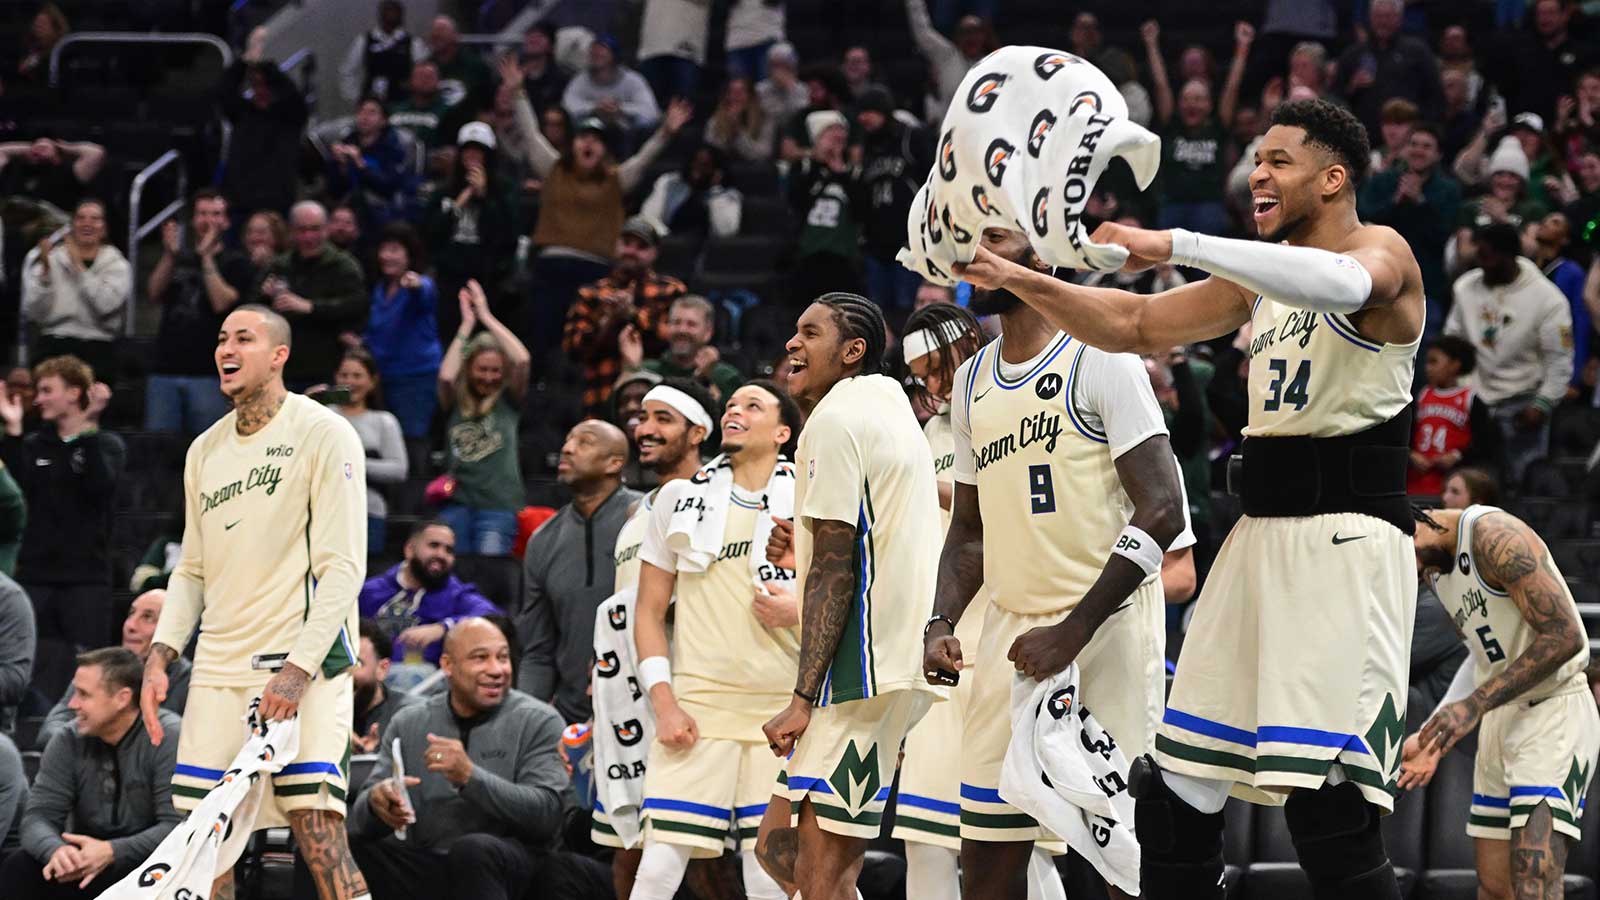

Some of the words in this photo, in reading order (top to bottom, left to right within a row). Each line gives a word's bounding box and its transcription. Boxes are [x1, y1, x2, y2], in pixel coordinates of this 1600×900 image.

[967, 73, 1008, 113] G
[1028, 109, 1057, 158] G
[985, 138, 1016, 187] G
[1264, 359, 1311, 411] 34
[1020, 411, 1063, 454] City
[1418, 424, 1448, 453] 34
[246, 464, 282, 496] City
[1028, 464, 1056, 514] 9
[1116, 535, 1141, 551] BP
[1462, 587, 1487, 618] City
[1475, 625, 1506, 664] 5
[1047, 685, 1075, 720] G
[613, 718, 643, 747] G
